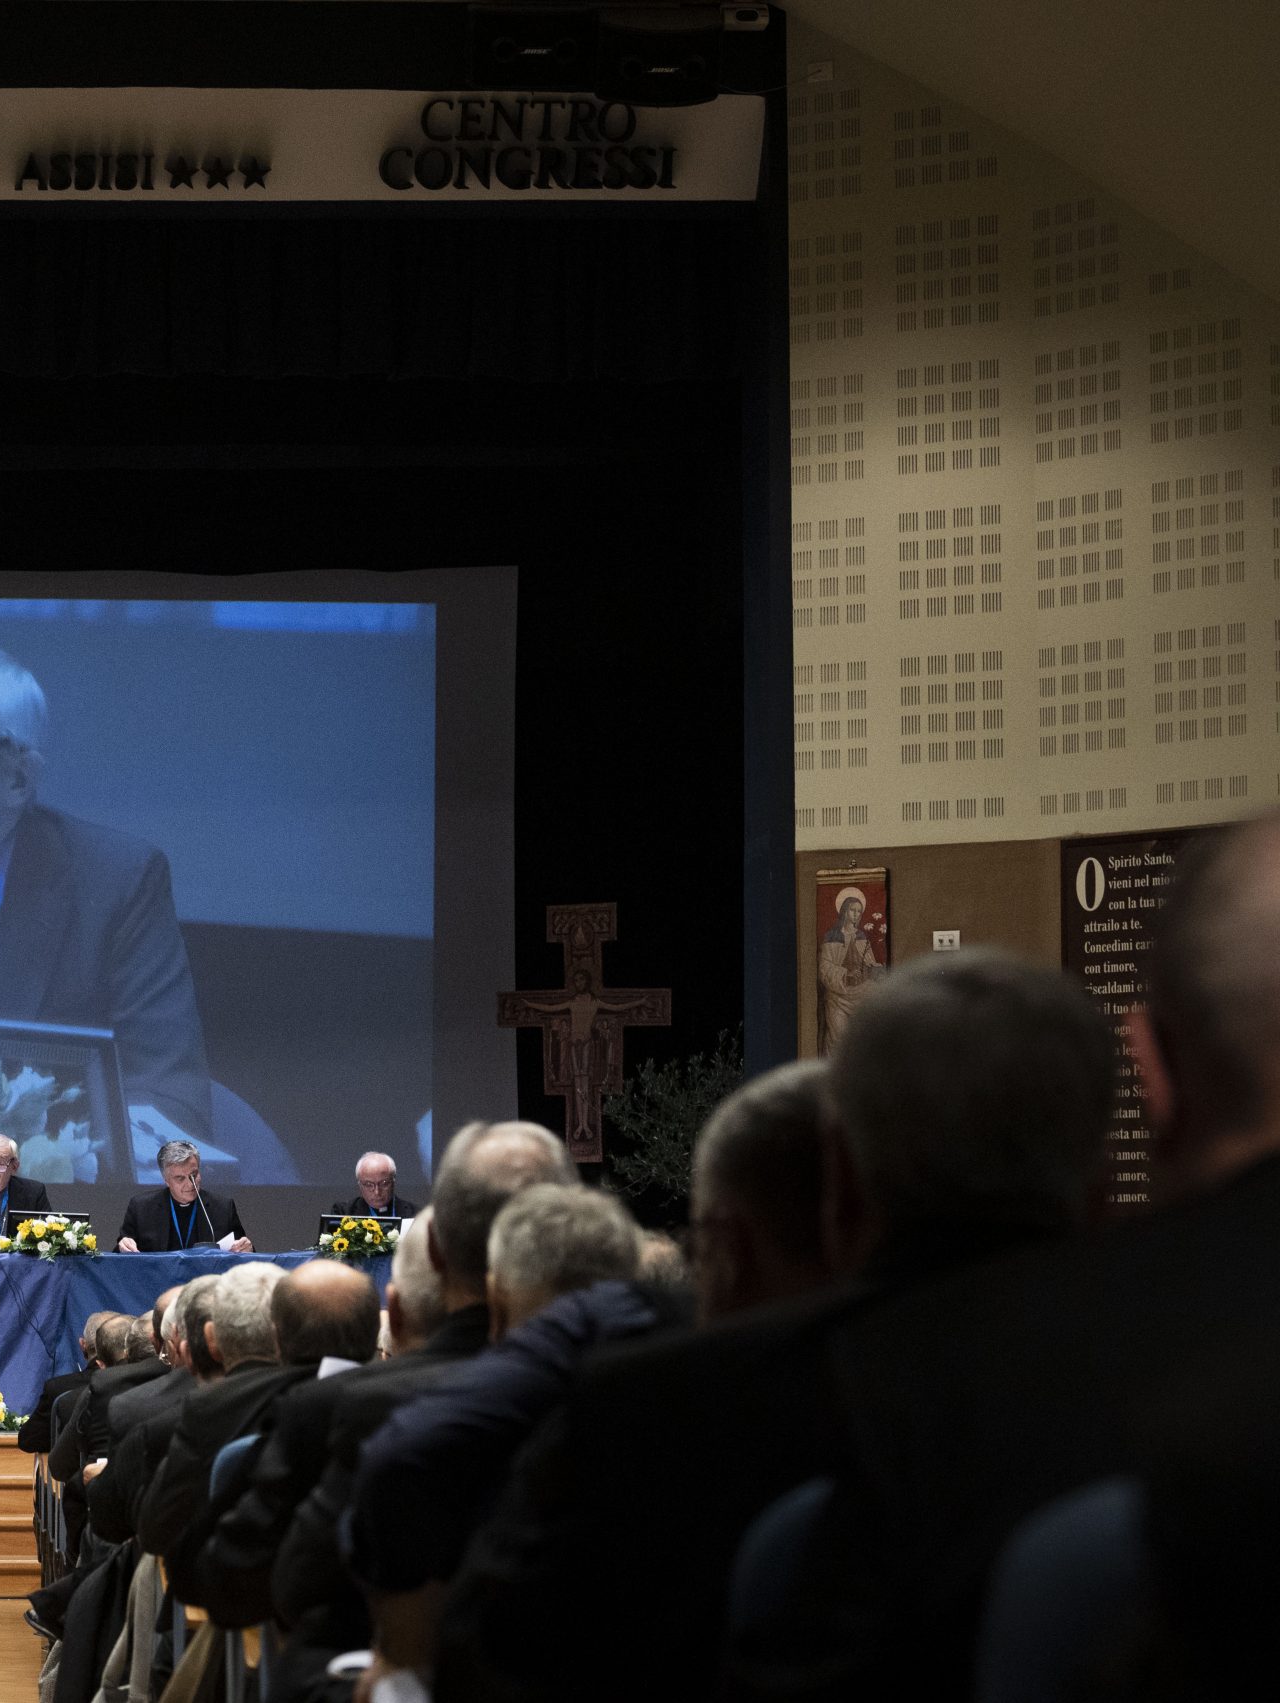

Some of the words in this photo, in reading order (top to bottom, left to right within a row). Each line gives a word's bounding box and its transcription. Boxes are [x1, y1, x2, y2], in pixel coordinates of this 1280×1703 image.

[422, 99, 635, 142] CENTRO
[15, 154, 154, 191] ASSISI
[379, 146, 677, 190] CONGRESSI
[1076, 857, 1105, 912] O
[1108, 856, 1141, 871] Spirito
[1109, 876, 1132, 889] vieni
[1134, 874, 1149, 888] nel
[1152, 873, 1170, 886] mio
[1109, 900, 1125, 911] con
[1128, 896, 1137, 909] la
[1140, 896, 1155, 909] tua
[1084, 918, 1120, 933] attrailo
[1122, 921, 1128, 931] a
[1084, 939, 1133, 954] Concedimi
[1084, 964, 1101, 975] con
[1103, 960, 1138, 974] timore,
[1113, 1002, 1129, 1015] tuo
[1116, 1151, 1150, 1162] amore,
[1116, 1172, 1151, 1183] amore,
